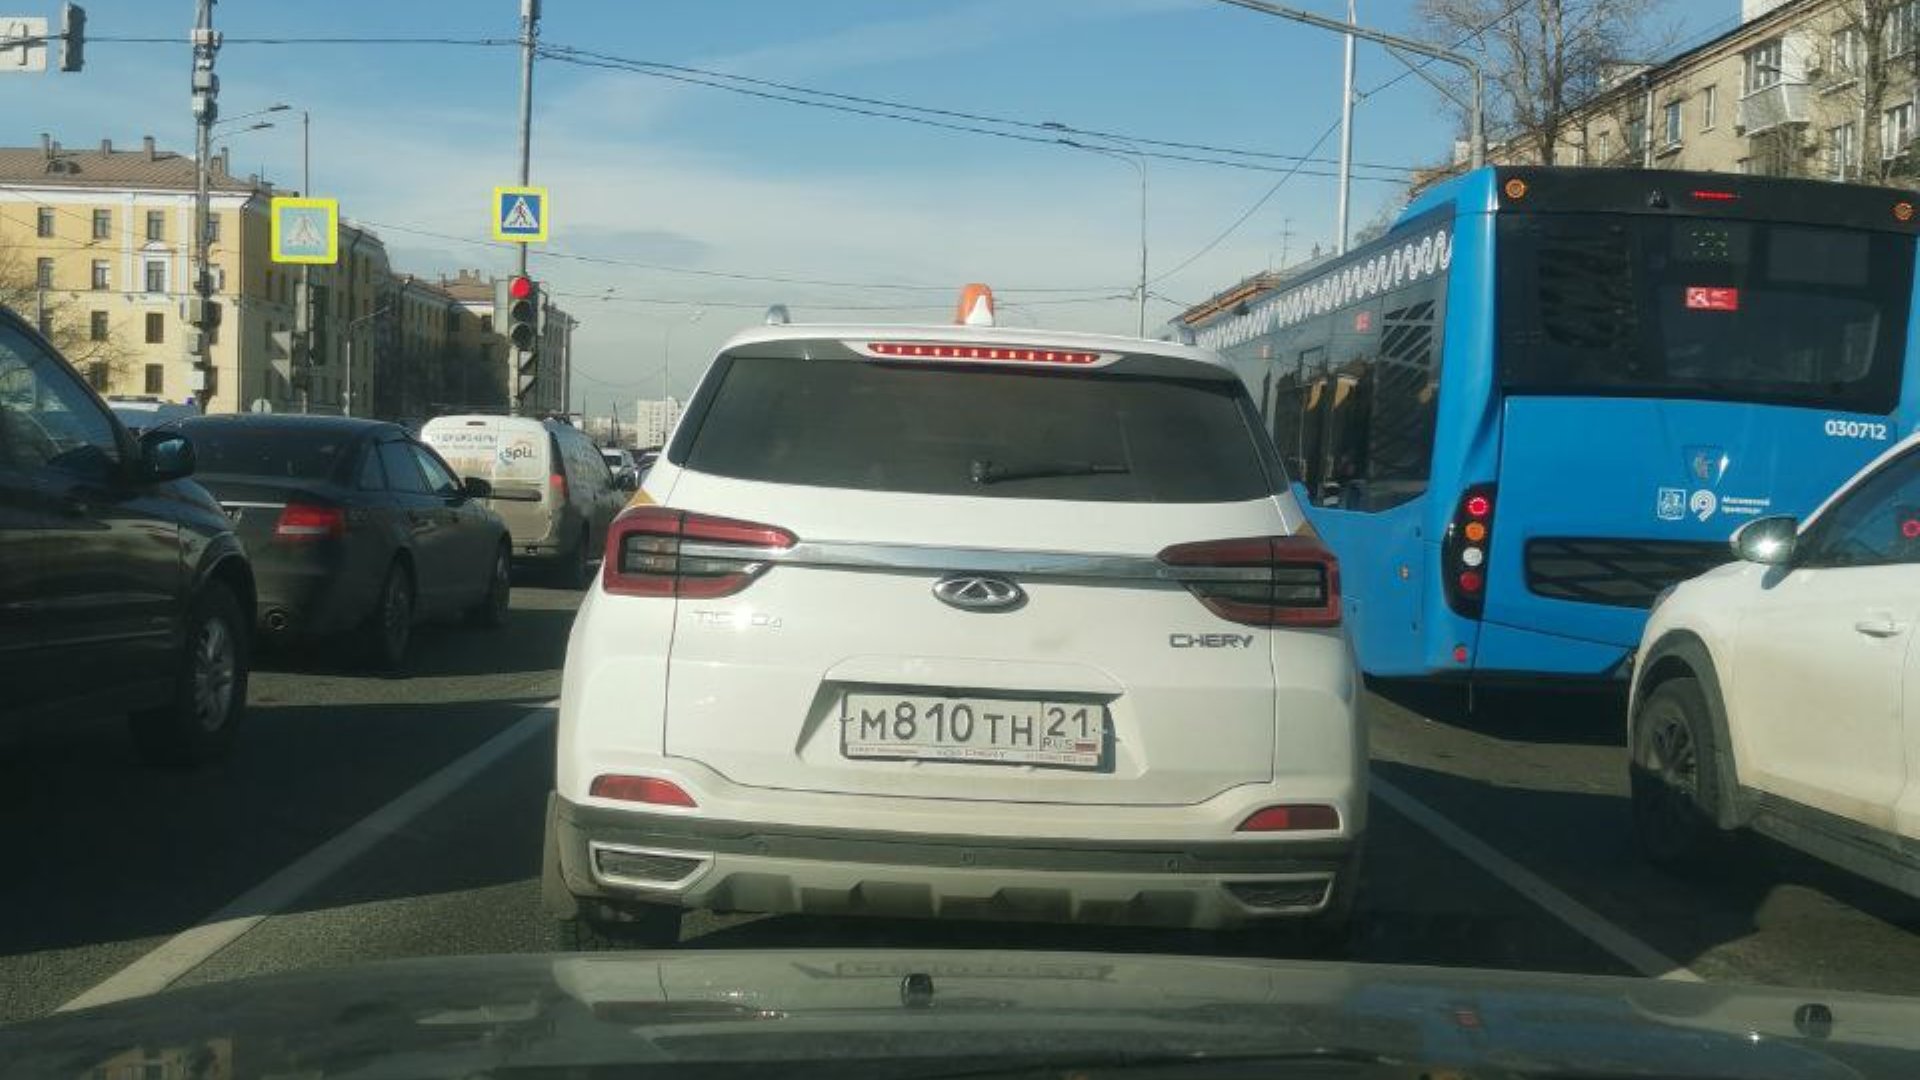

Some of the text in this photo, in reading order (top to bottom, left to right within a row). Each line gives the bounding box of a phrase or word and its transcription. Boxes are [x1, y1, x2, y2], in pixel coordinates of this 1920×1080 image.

[1824, 420, 1887, 440] 030712
[1169, 633, 1254, 649] CHERY
[1047, 707, 1088, 737] 21
[1043, 736, 1074, 751] RUS
